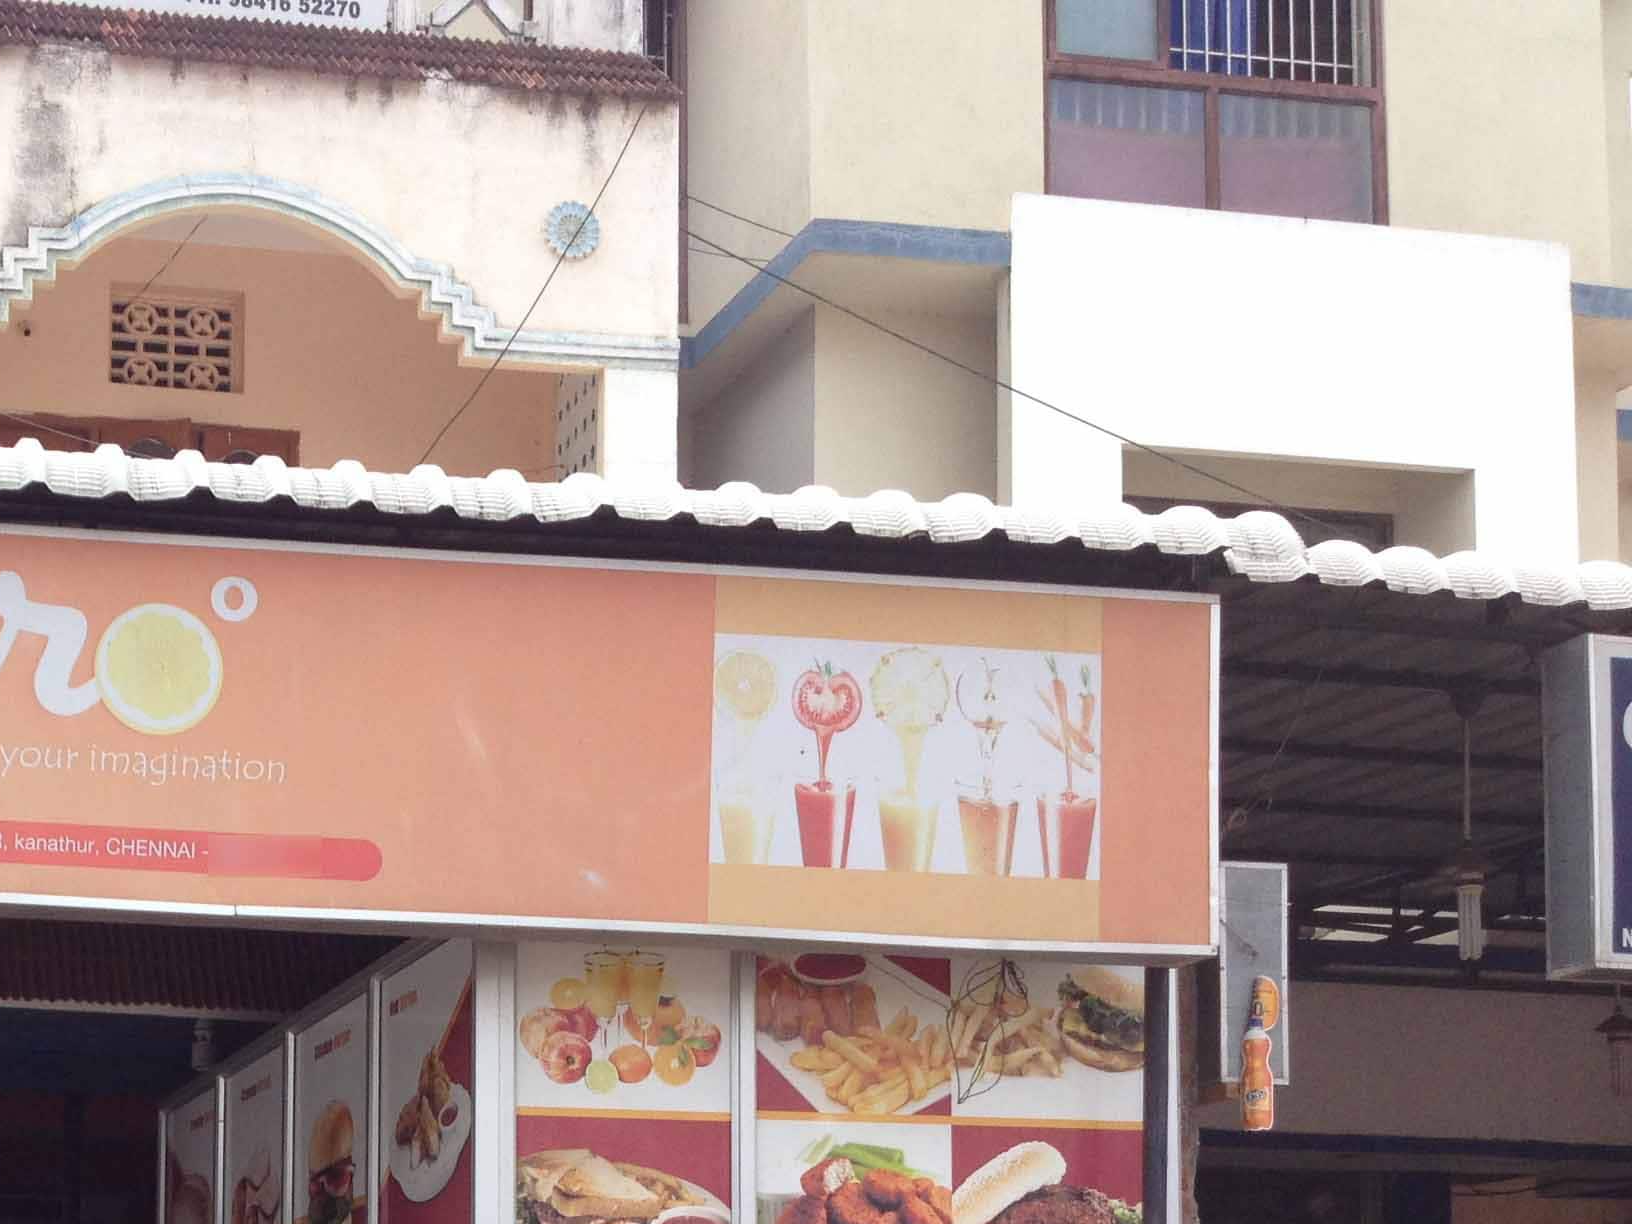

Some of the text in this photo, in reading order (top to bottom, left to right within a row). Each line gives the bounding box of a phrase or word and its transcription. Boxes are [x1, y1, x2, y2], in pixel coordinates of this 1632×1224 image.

[298, 0, 361, 19] 52270
[0, 743, 79, 777] your
[89, 744, 287, 786] imagination
[13, 834, 100, 858] kanathur,
[105, 837, 196, 860] CHENNAI
